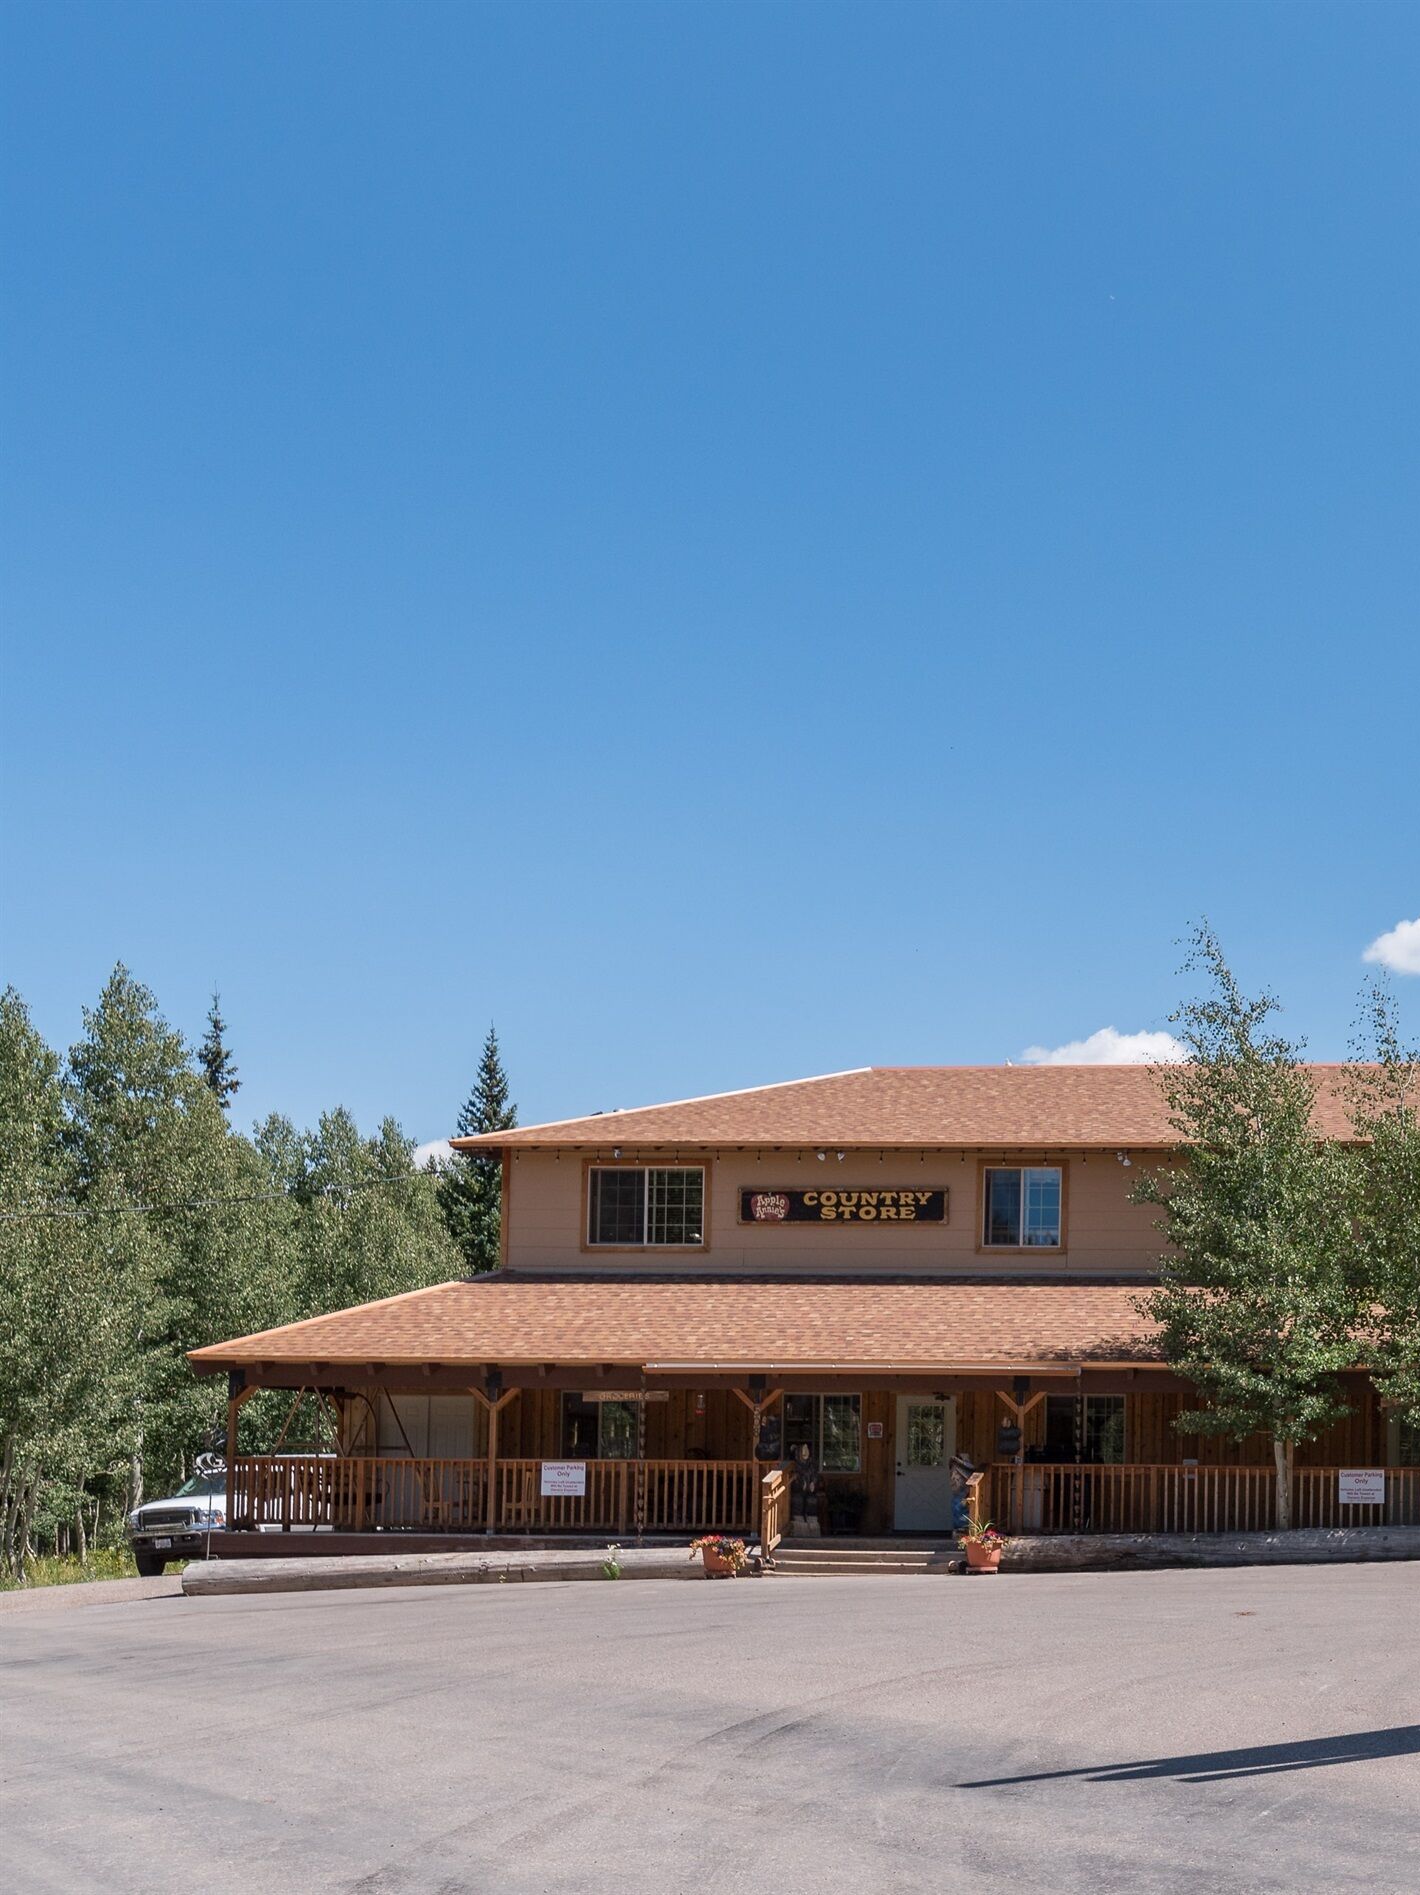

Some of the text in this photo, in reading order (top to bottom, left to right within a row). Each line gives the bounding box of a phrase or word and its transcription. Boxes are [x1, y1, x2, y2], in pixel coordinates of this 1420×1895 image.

[756, 1194, 786, 1207] Apple
[803, 1191, 933, 1206] COUNTRY
[820, 1206, 916, 1220] STORE
